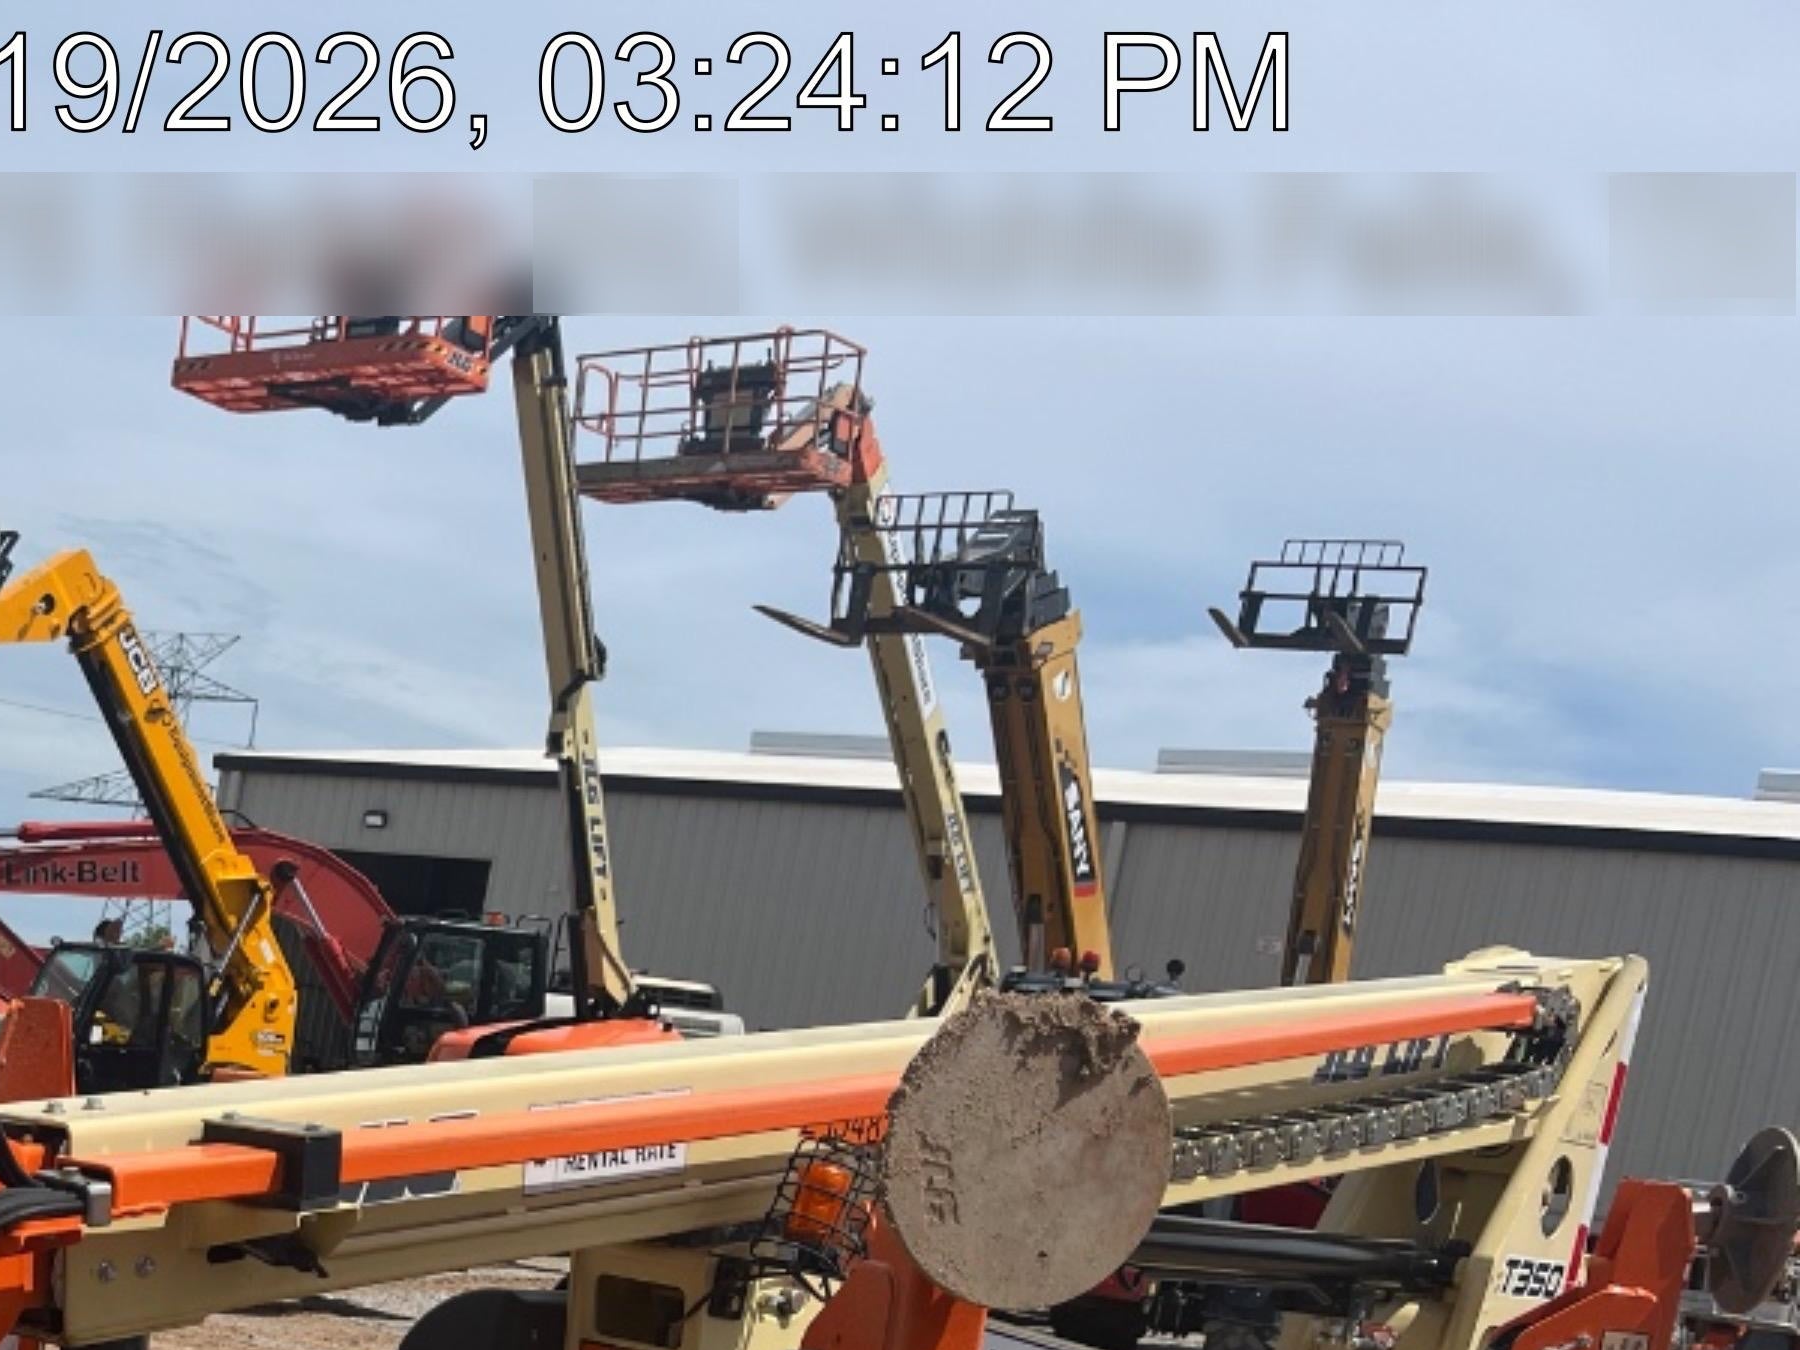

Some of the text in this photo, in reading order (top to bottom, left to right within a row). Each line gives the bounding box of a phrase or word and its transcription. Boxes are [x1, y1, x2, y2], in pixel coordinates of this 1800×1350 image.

[119, 628, 157, 695] JCB
[581, 752, 608, 879] JLG LIFT
[4, 858, 141, 886] Link-Belt
[634, 1141, 679, 1164] RATE
[1503, 1258, 1565, 1298] T350
